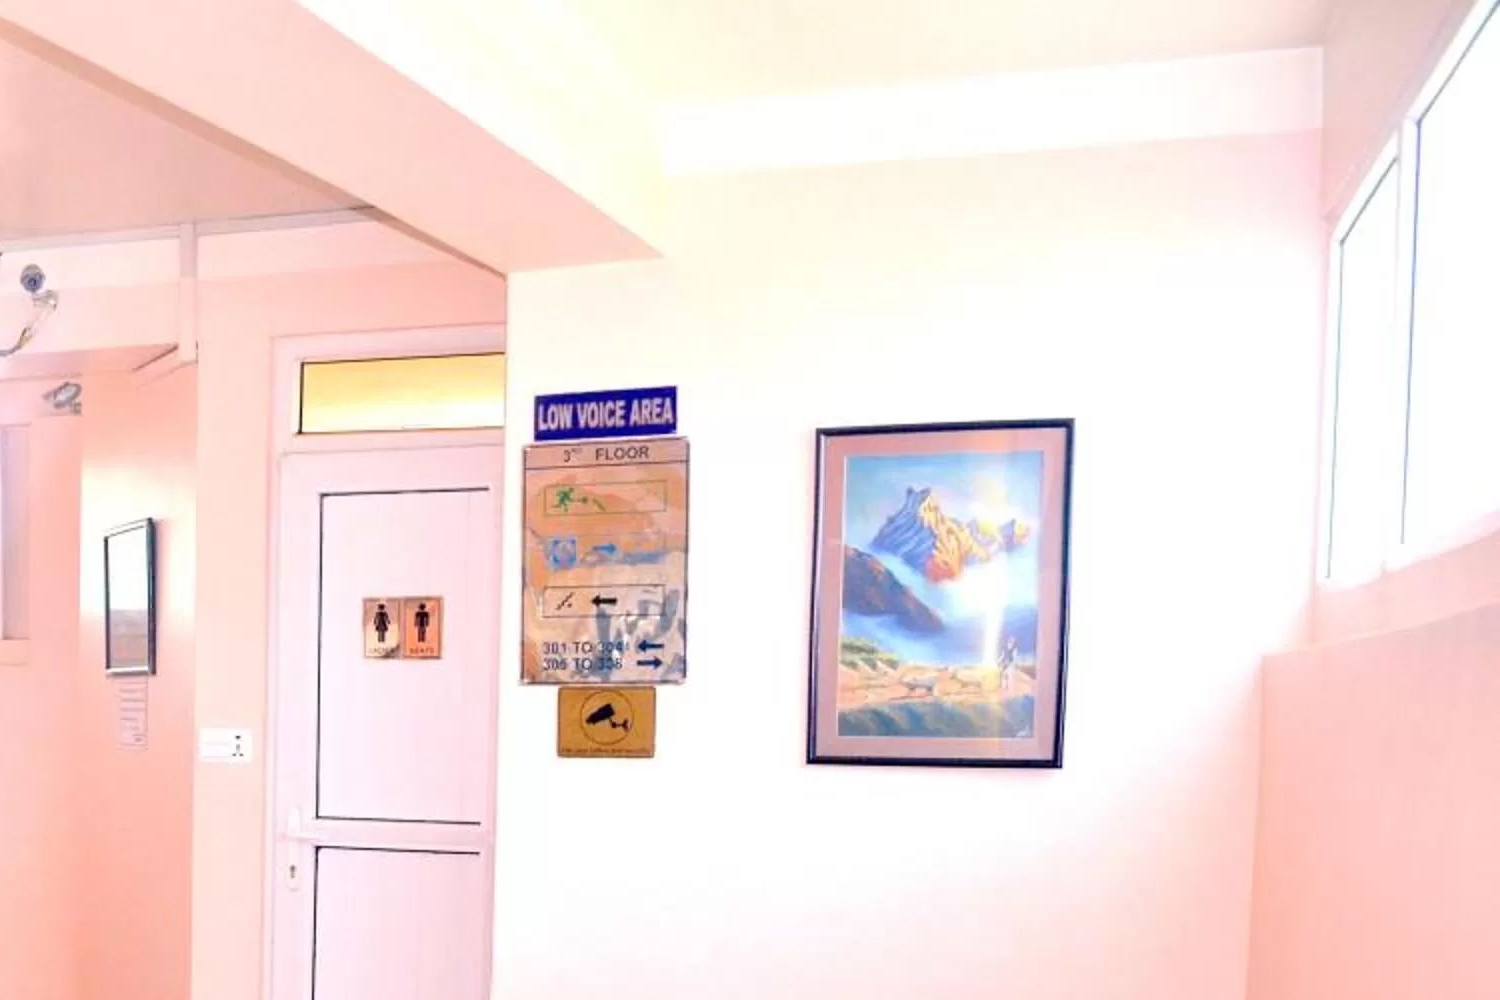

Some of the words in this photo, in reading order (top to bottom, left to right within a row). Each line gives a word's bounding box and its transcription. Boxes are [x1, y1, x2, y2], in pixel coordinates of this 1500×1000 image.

[538, 404, 573, 431] LOW
[577, 401, 625, 429] VOICE
[630, 397, 673, 426] AREA
[595, 445, 649, 461] FLOOR
[572, 641, 593, 654] TO
[572, 657, 593, 671] TO
